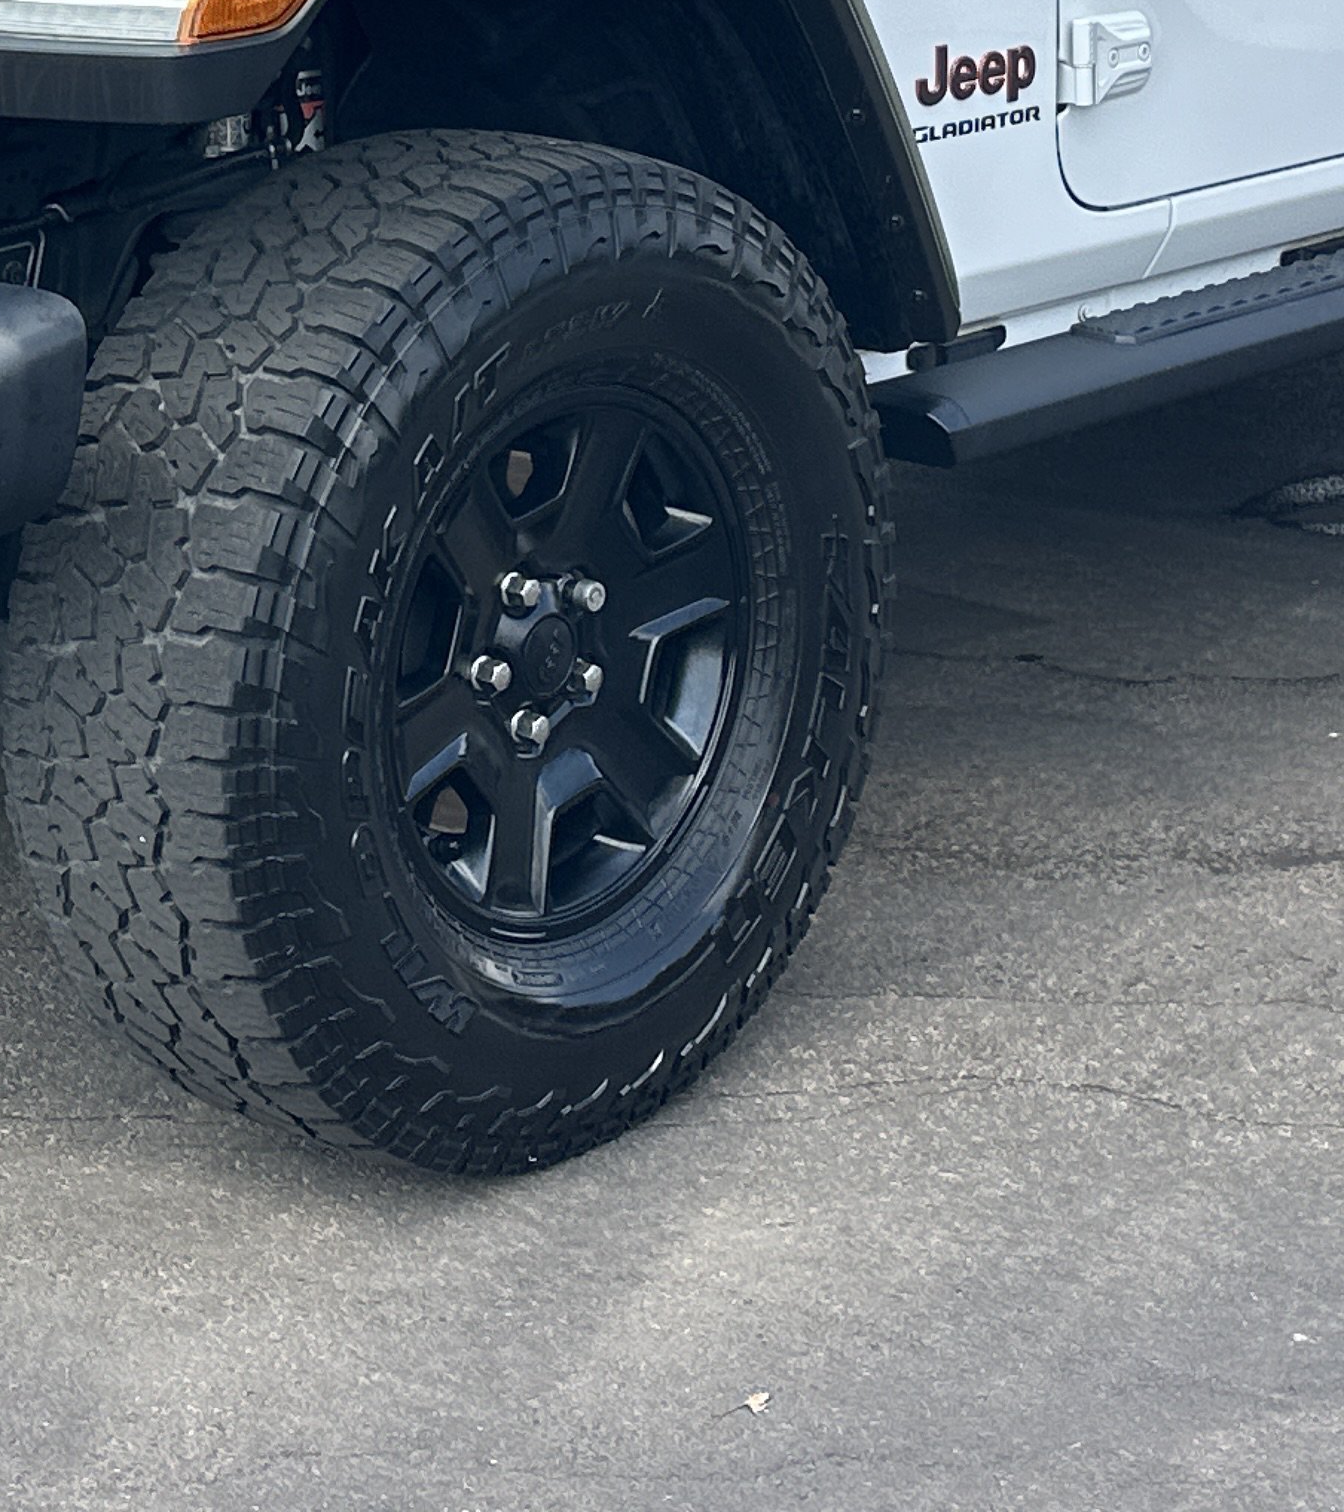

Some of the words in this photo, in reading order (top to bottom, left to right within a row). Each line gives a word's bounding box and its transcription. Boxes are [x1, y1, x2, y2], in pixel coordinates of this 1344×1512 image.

[915, 44, 1036, 106] Jeep
[912, 106, 1041, 144] GLADIATOR
[711, 530, 850, 966] FALKEN
